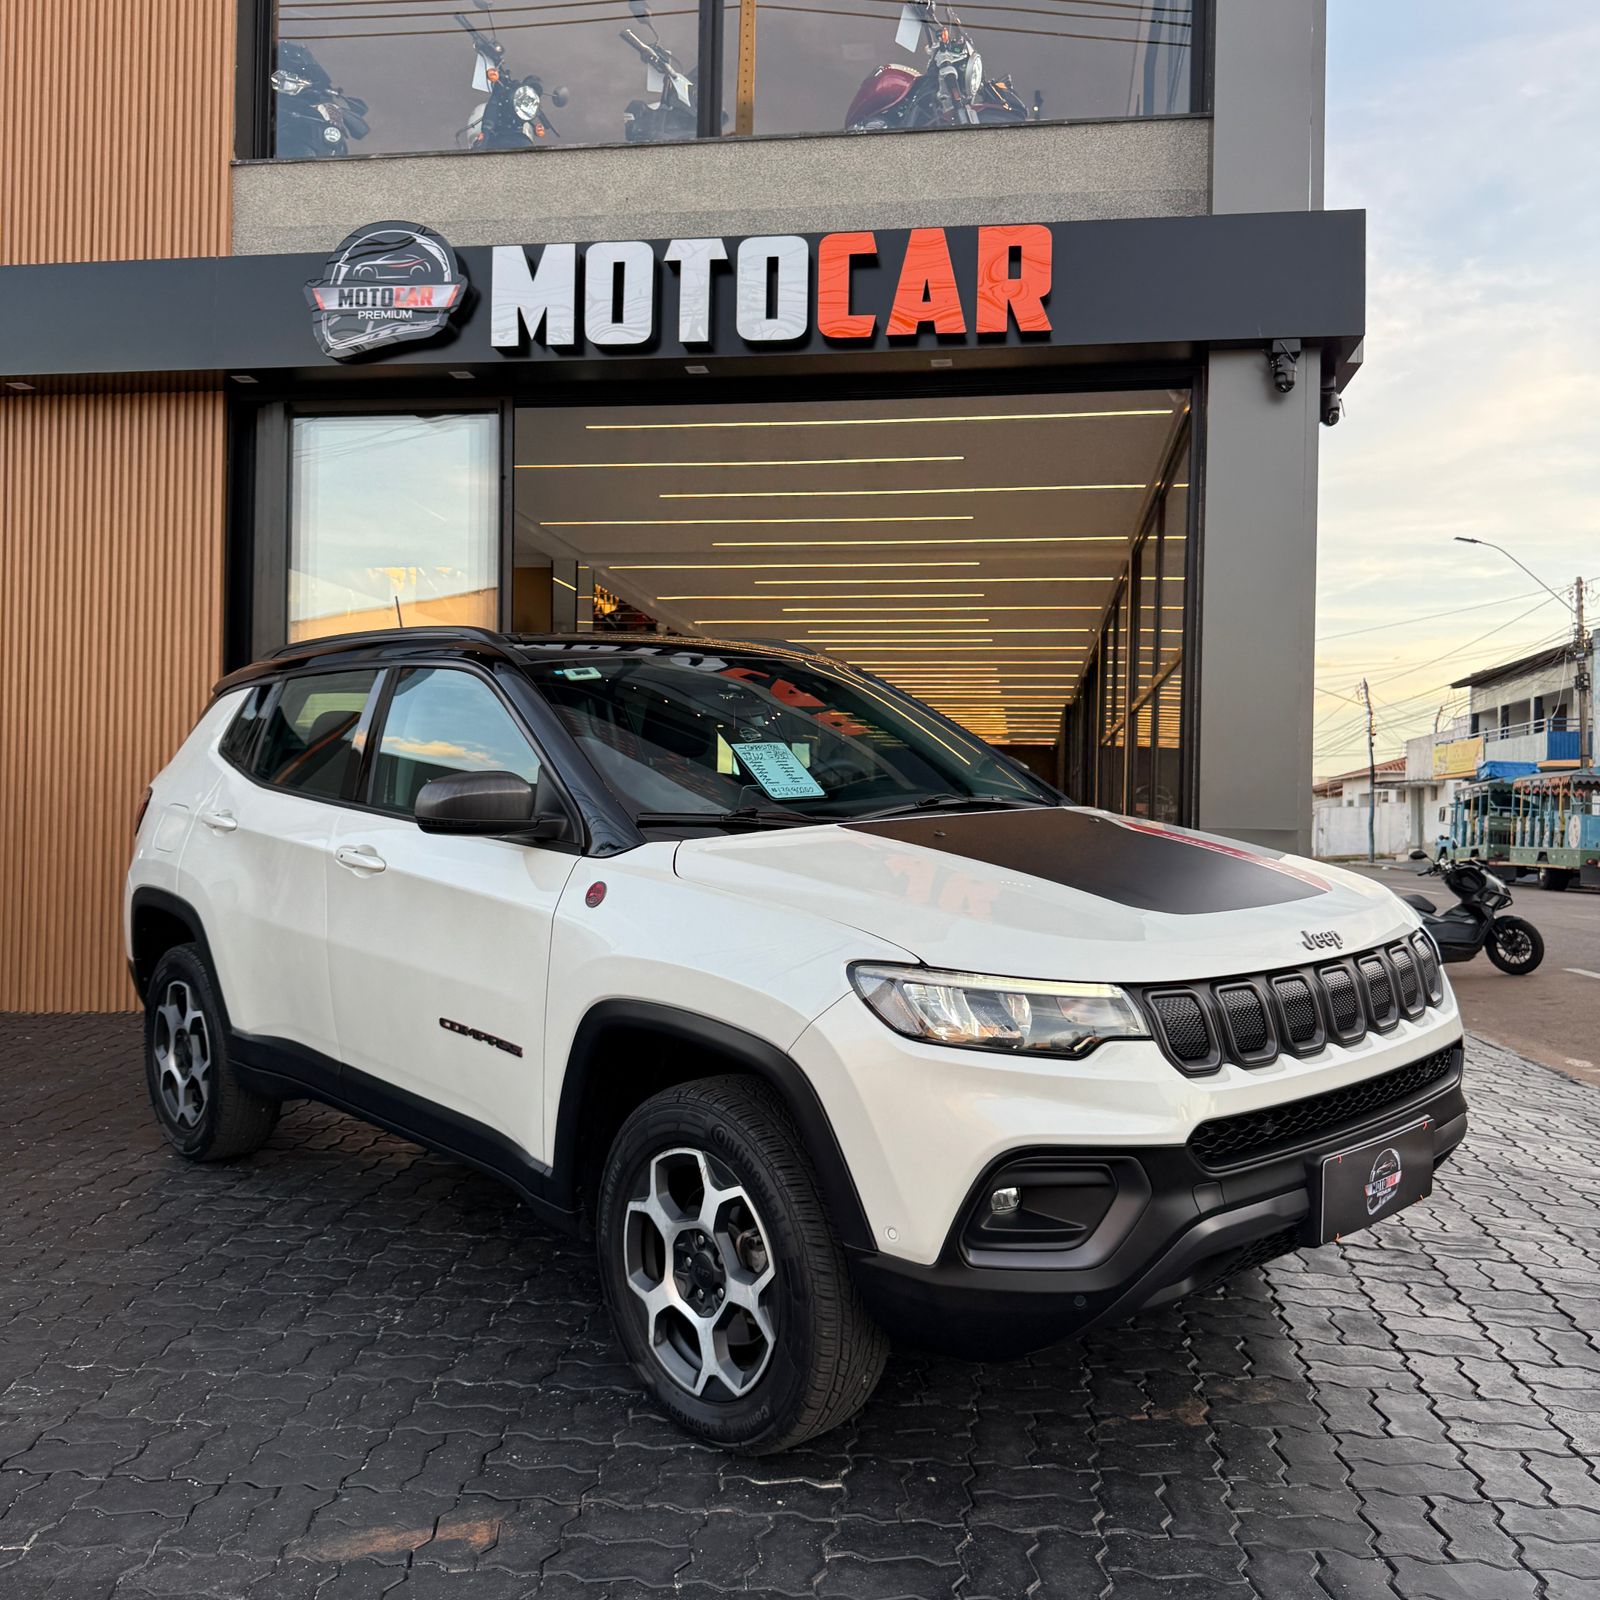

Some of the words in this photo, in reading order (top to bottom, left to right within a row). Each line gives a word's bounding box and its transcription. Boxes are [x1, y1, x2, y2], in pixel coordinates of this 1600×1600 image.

[491, 224, 1052, 347] MOTOCAR
[338, 287, 433, 308] MOTOCAR
[358, 310, 412, 320] PREMIUM
[1301, 930, 1343, 950] Jeep
